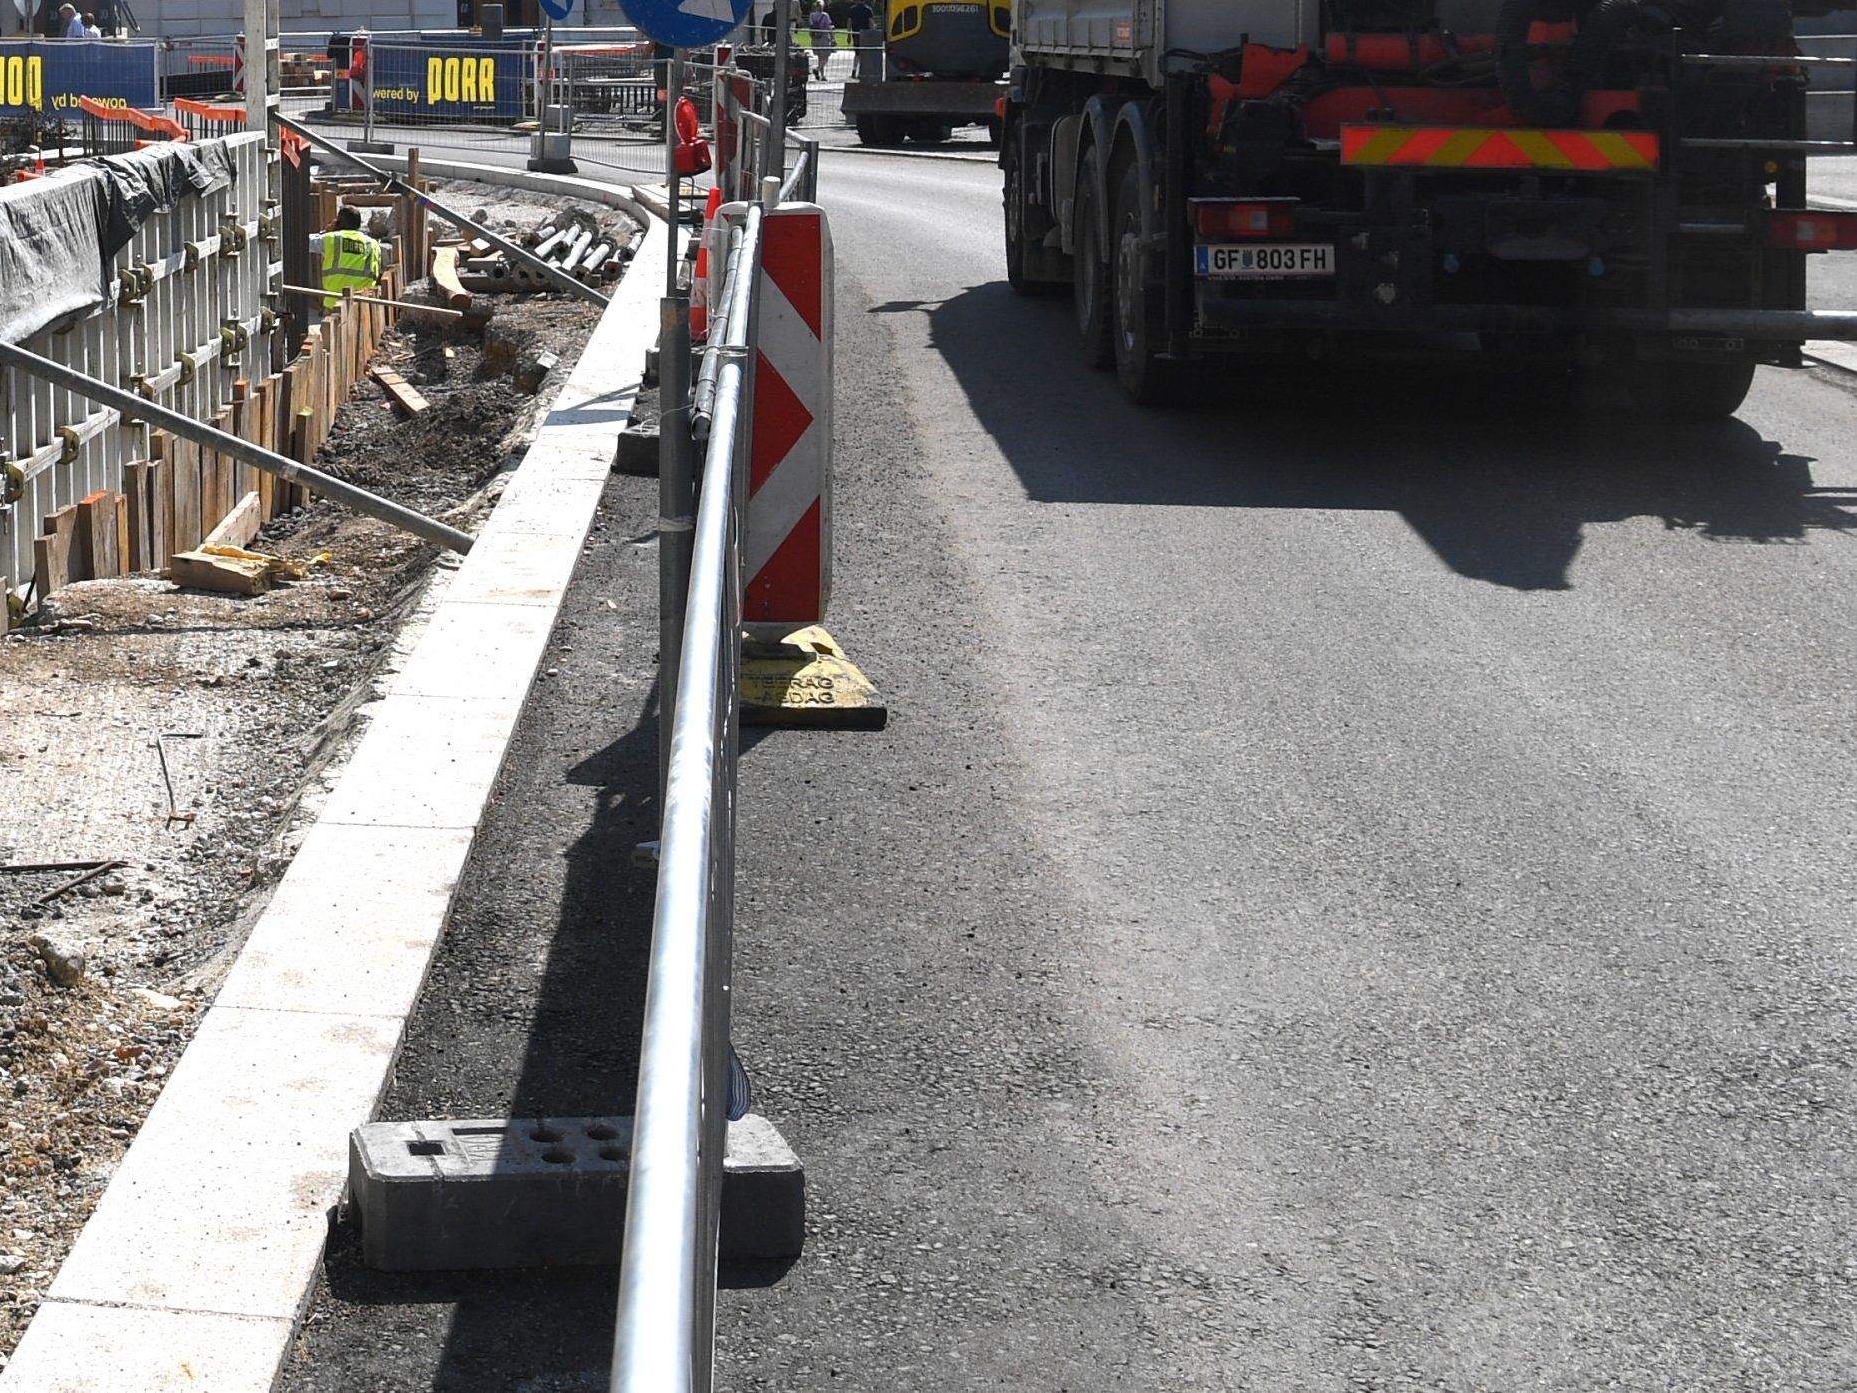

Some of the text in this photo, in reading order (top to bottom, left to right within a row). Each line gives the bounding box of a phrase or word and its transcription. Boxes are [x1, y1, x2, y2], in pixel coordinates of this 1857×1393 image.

[406, 88, 420, 104] by
[427, 57, 495, 105] PORR
[1214, 249, 1326, 270] GF 803 FH
